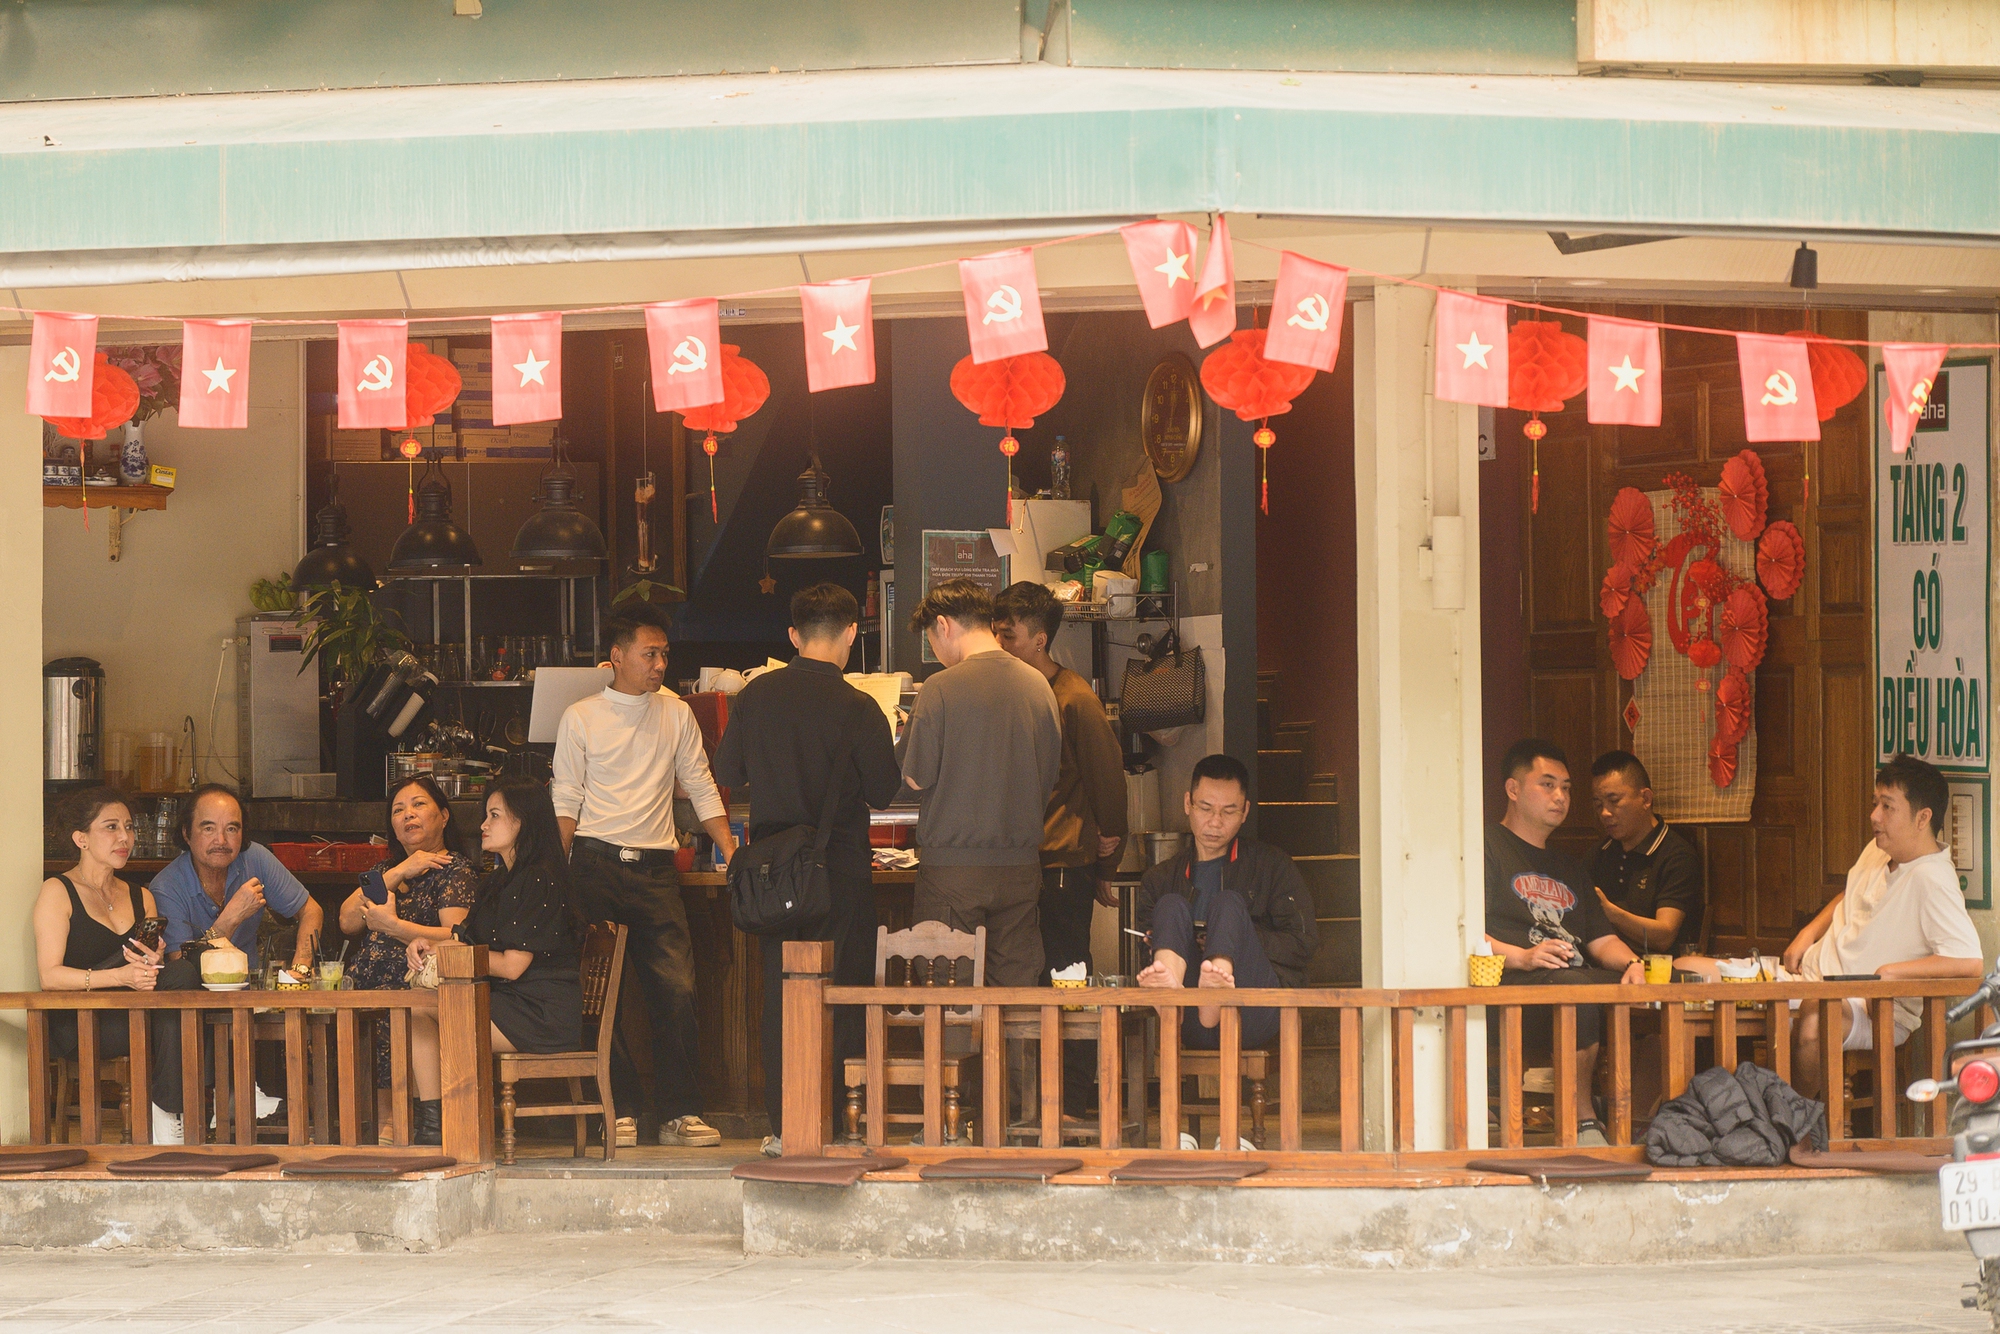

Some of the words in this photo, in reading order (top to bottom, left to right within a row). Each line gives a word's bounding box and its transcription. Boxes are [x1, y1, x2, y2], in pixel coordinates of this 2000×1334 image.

[1920, 399, 1946, 420] aha
[1890, 436, 1946, 543] TẦNG
[1952, 462, 1966, 542] 2
[958, 550, 972, 559] aha
[1913, 552, 1941, 650] CÓ
[1882, 650, 1930, 756] ĐIỀU
[1936, 657, 1981, 758] HÒA
[1949, 1197, 2000, 1225] 010.
